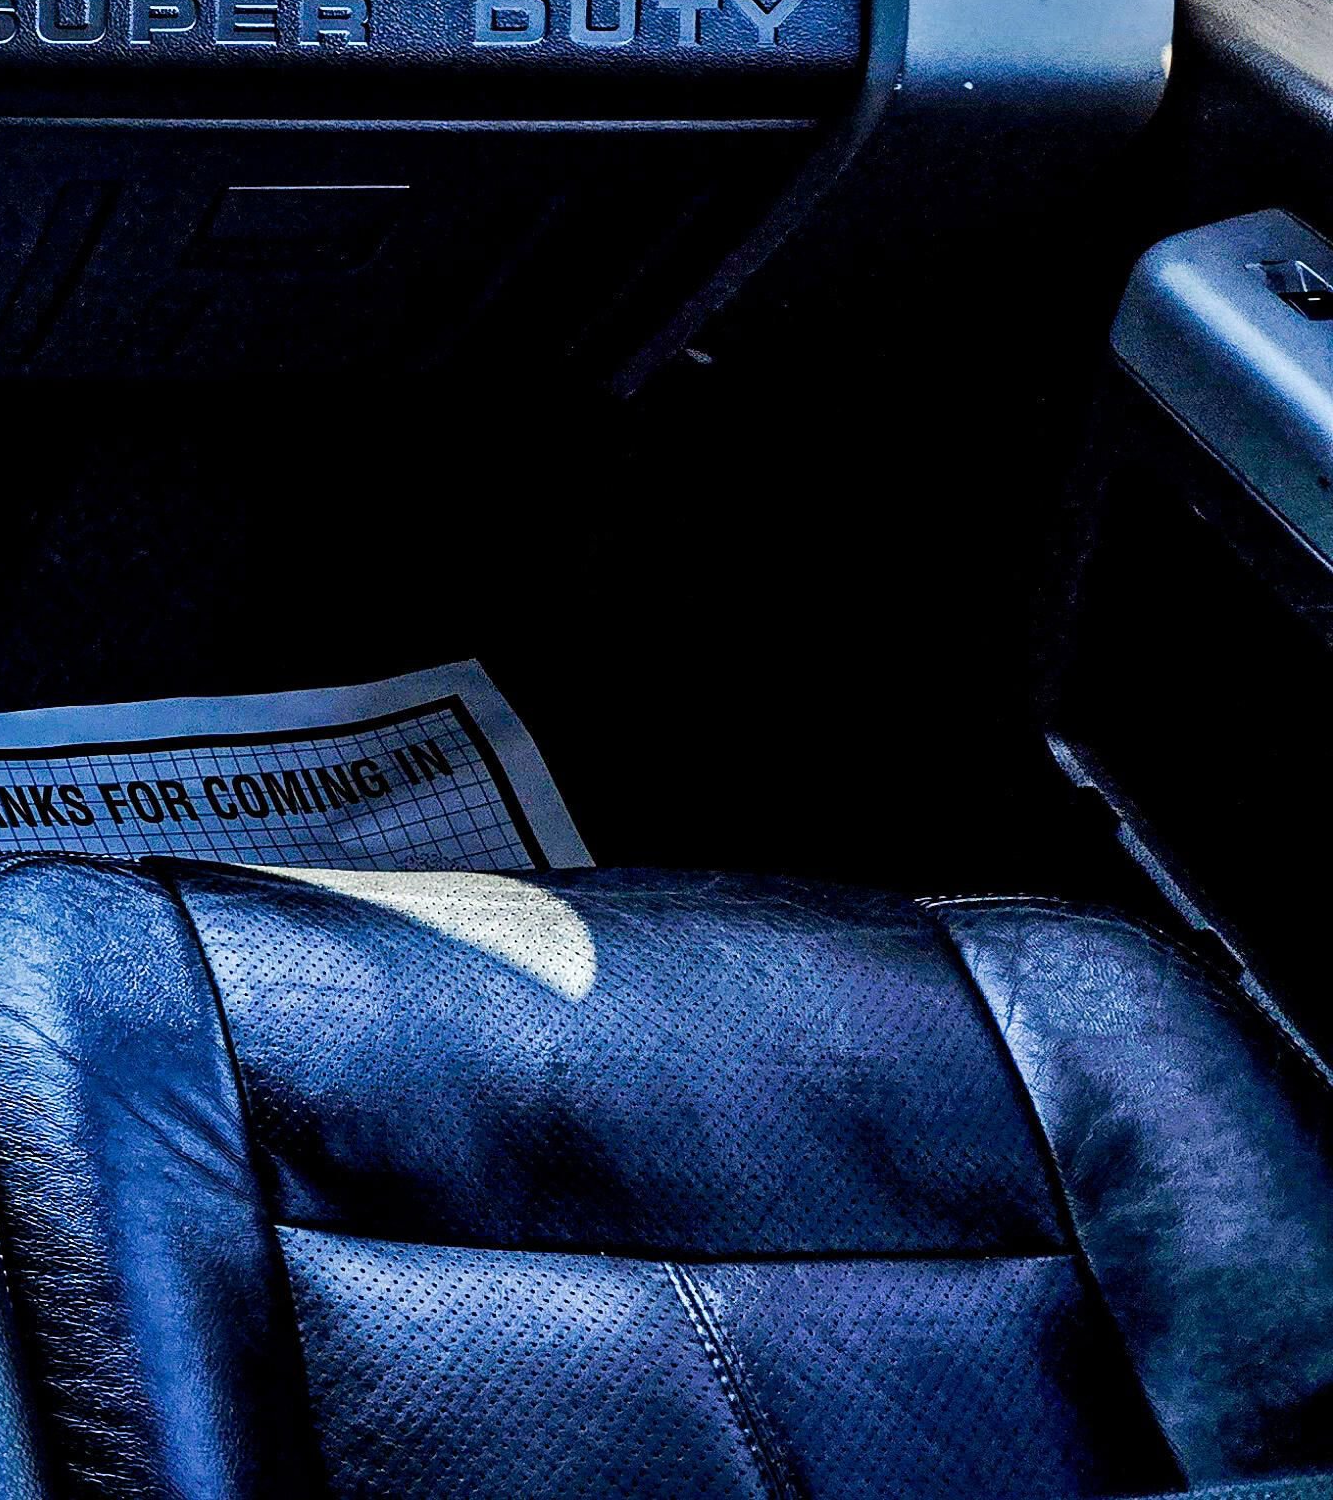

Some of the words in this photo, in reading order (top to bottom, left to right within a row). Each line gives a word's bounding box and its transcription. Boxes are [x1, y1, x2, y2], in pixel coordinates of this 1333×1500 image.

[107, 779, 193, 826] FOR
[209, 757, 392, 823] COMING
[399, 738, 456, 787] IN
